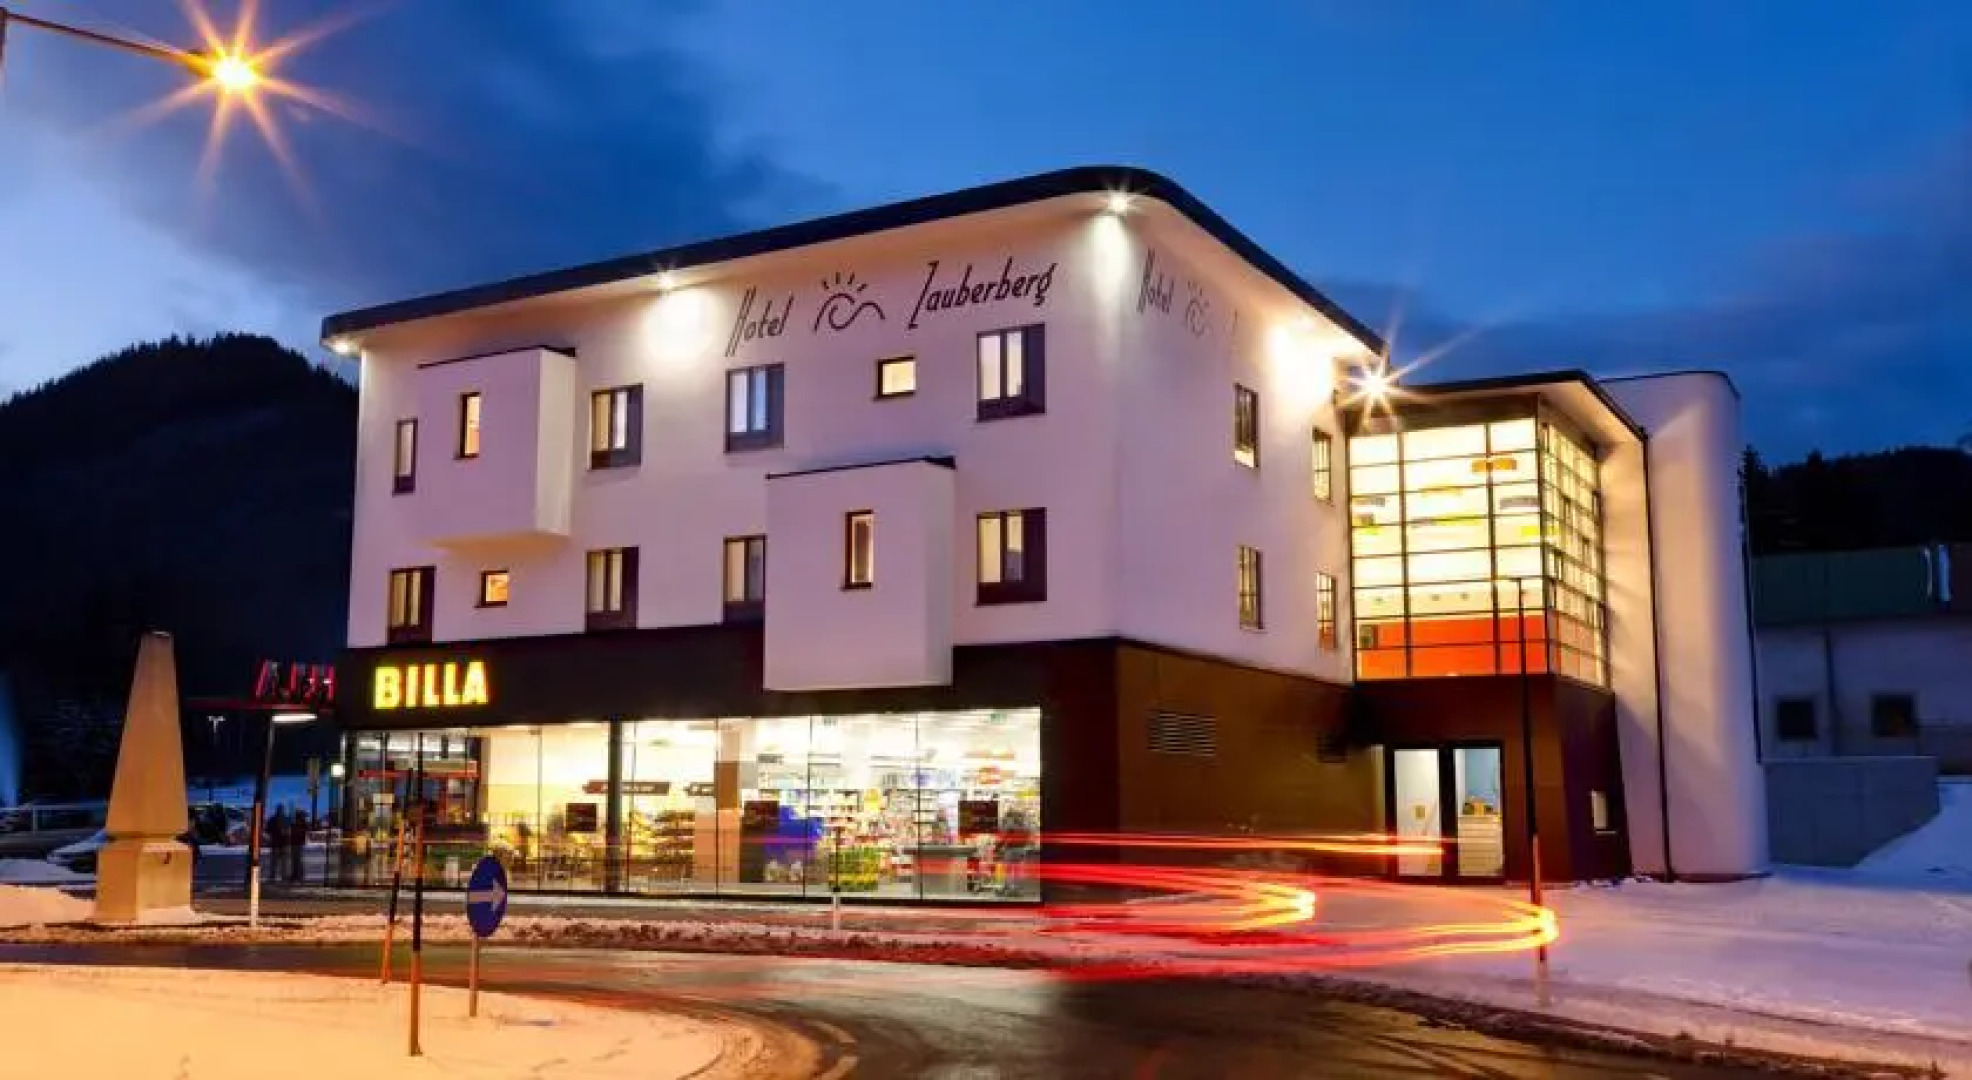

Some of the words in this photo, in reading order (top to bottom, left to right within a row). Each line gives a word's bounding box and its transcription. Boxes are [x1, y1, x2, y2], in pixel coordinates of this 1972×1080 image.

[725, 286, 794, 357] Hotel
[908, 257, 1058, 330] Zauberberg
[374, 661, 488, 709] BILLA
